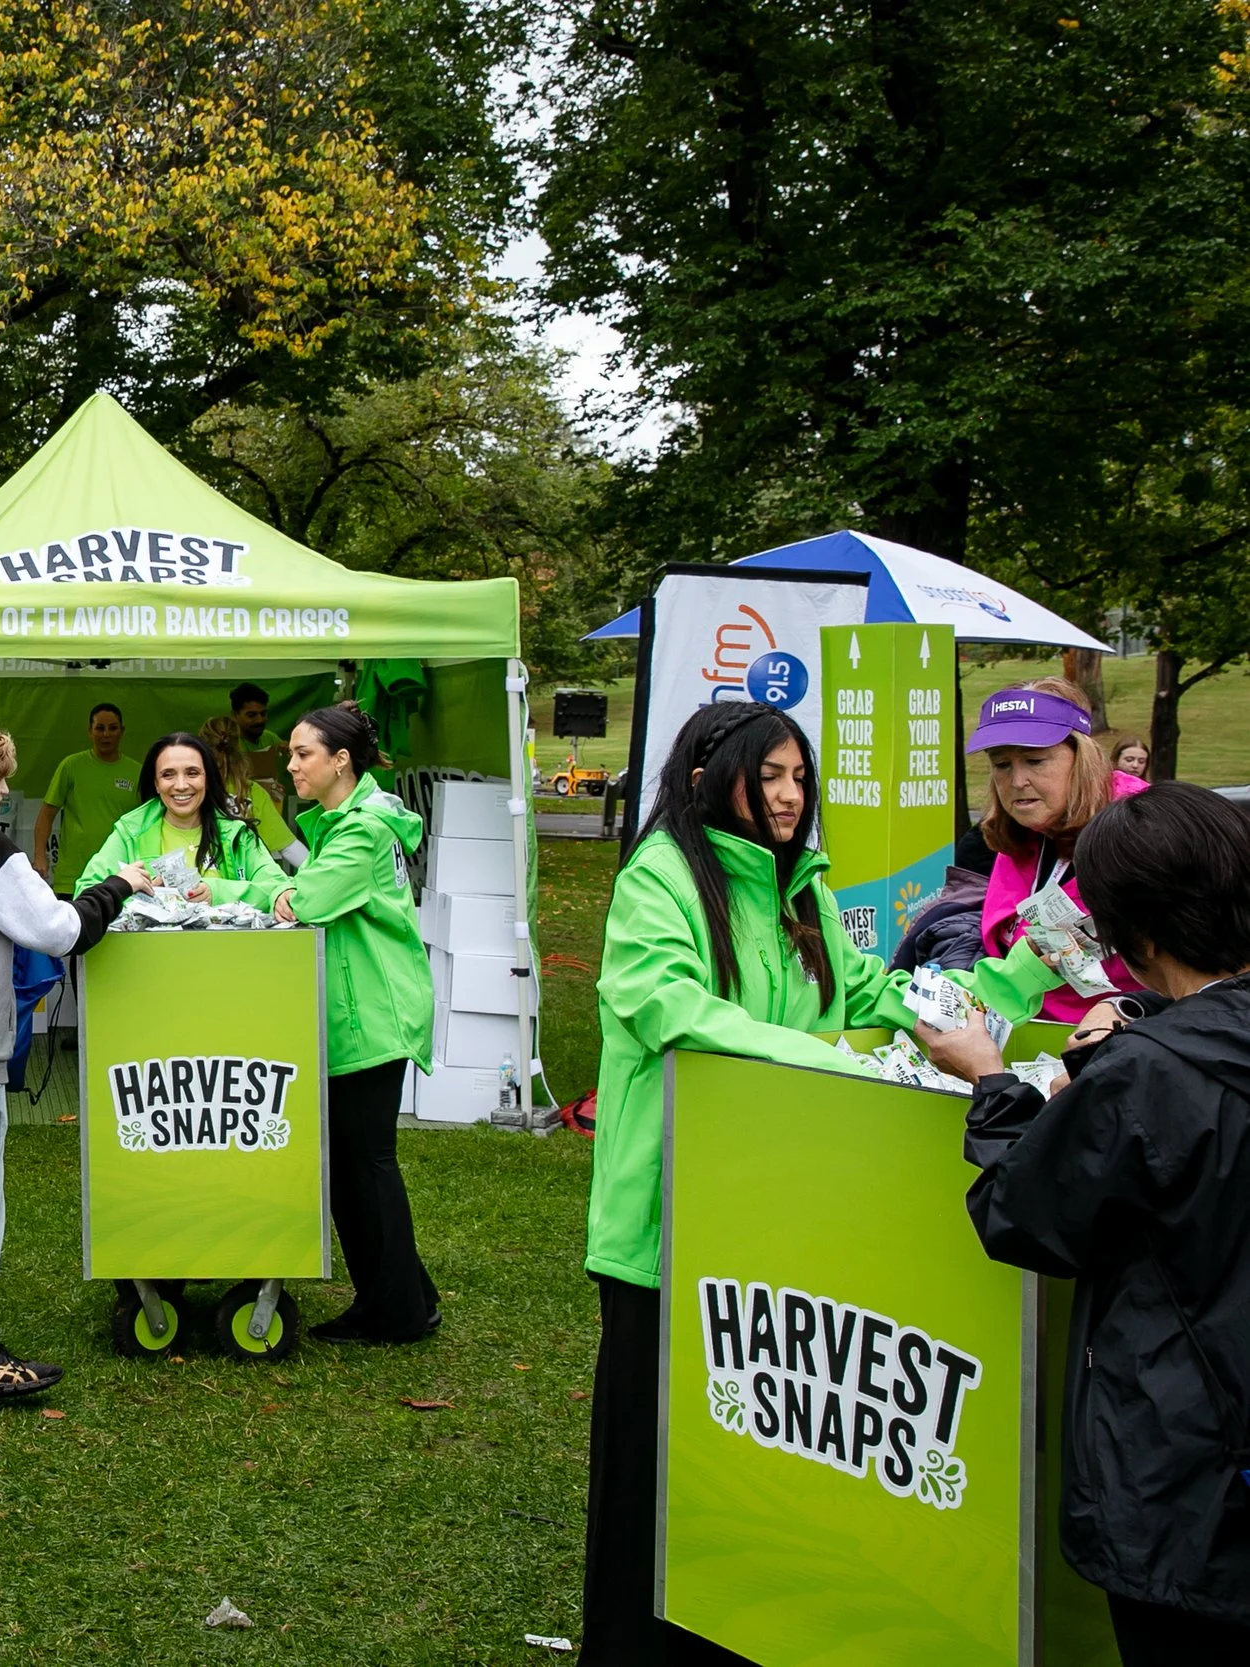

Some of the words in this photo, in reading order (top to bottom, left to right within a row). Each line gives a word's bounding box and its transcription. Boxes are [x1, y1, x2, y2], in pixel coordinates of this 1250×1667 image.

[0, 530, 244, 583] HARVEST
[2, 606, 34, 636] OF
[43, 606, 156, 637] FLAVOUR
[166, 607, 250, 638] BAKED
[258, 608, 350, 638] CRISPS
[766, 660, 790, 703] 91.5
[837, 689, 874, 715] GRAB
[908, 689, 941, 715] GRAB
[995, 700, 1029, 713] HESTA
[837, 719, 873, 746] YOUR
[908, 719, 941, 746] YOUR
[837, 750, 872, 776] FREE
[909, 750, 940, 776] FREE
[827, 778, 881, 808] SNACKS
[900, 779, 948, 808] SNACKS
[114, 1059, 294, 1116] HARVEST
[151, 1108, 260, 1146] SNAPS
[706, 1283, 977, 1445] HARVEST
[753, 1371, 917, 1487] SNAPS
